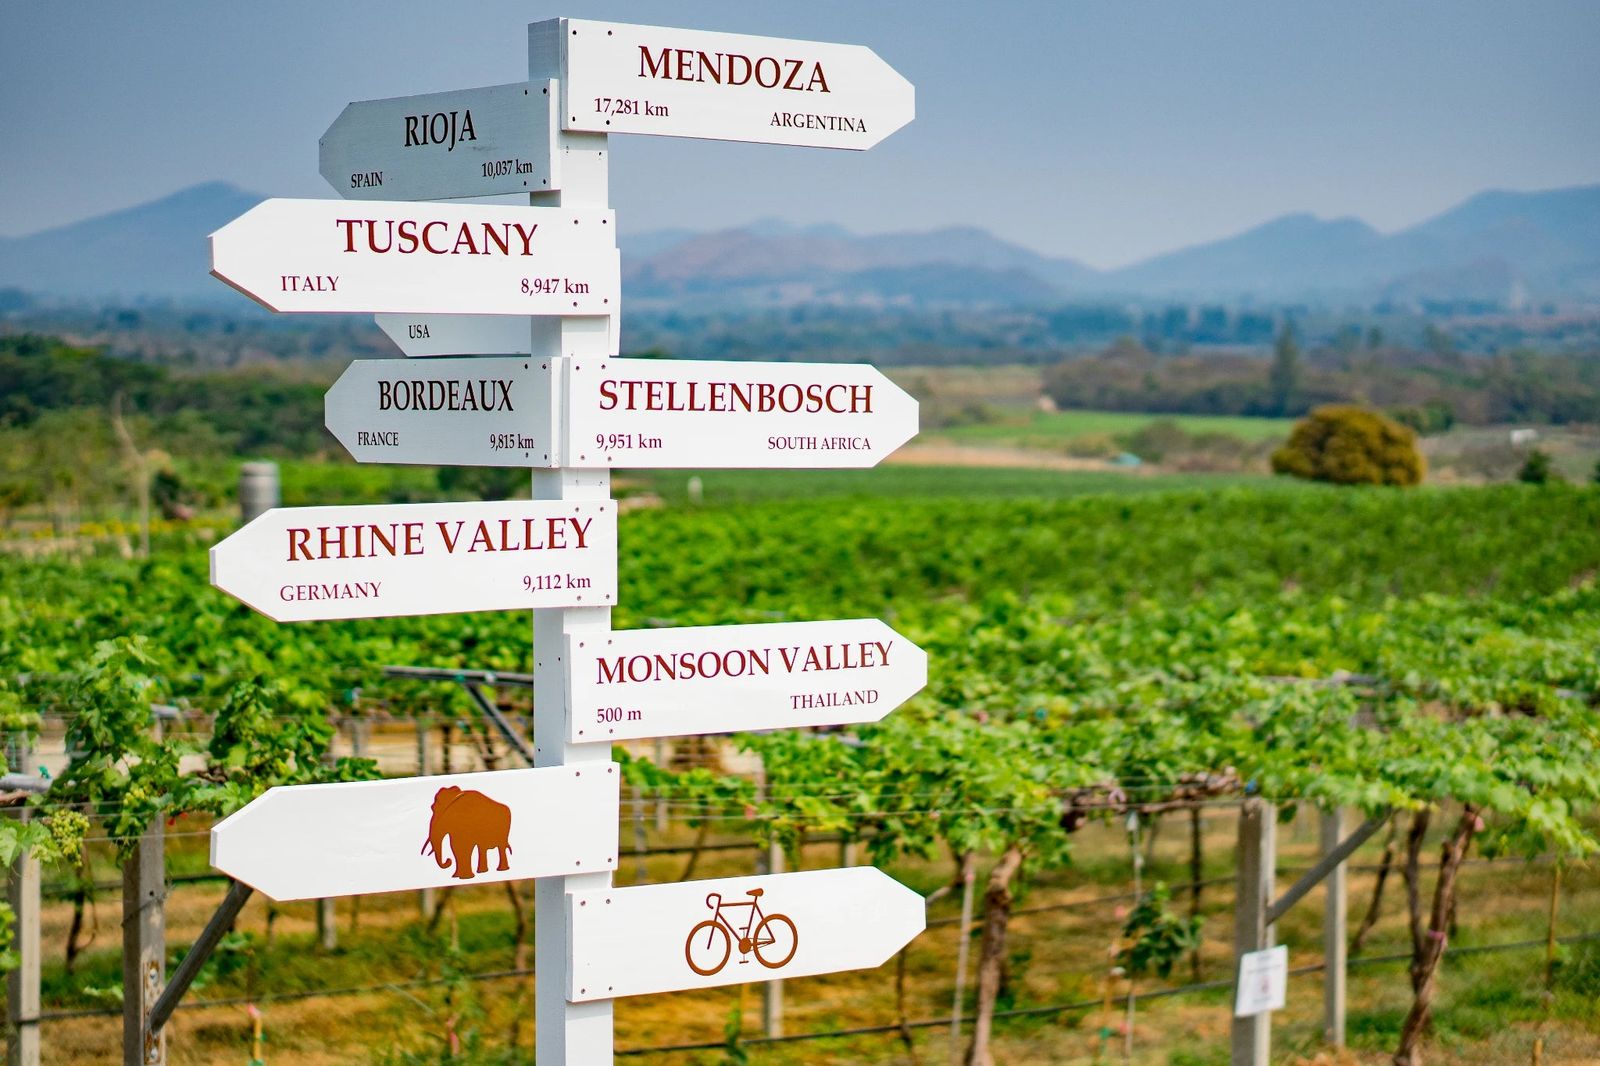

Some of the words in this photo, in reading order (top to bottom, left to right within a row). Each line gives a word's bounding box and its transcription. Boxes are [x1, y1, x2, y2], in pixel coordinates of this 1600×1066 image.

[638, 46, 830, 93] MENDOZA
[595, 97, 640, 116] 17,281
[644, 100, 669, 116] km
[405, 110, 476, 151] RIOJA
[771, 112, 866, 132] ARGENTINA
[481, 160, 513, 180] 10,037
[515, 159, 533, 174] km
[351, 172, 382, 188] SPAIN
[336, 219, 538, 255] TUSCANY
[281, 275, 339, 291] ITALY
[521, 279, 559, 297] 8,947
[564, 279, 590, 294] km
[409, 325, 430, 339] USA
[378, 380, 513, 411] BORDEAUX
[600, 380, 873, 413] STELLENBOSCH
[358, 432, 398, 446] FRANCE
[490, 434, 515, 452] 9,815
[518, 434, 534, 448] km
[596, 434, 633, 452] 9,951
[638, 434, 662, 449] km
[768, 436, 816, 450] SOUTH
[820, 436, 872, 450] AFRICA
[287, 523, 424, 561] RHINE
[436, 518, 592, 553] VALLEY
[280, 583, 380, 601] GERMANY
[523, 574, 561, 593] 9,112
[566, 574, 591, 588] km
[597, 649, 770, 684] MONSOON
[778, 641, 892, 673] VALLEY
[790, 689, 879, 709] THAILAND
[597, 706, 623, 724] 500
[627, 709, 642, 721] m
